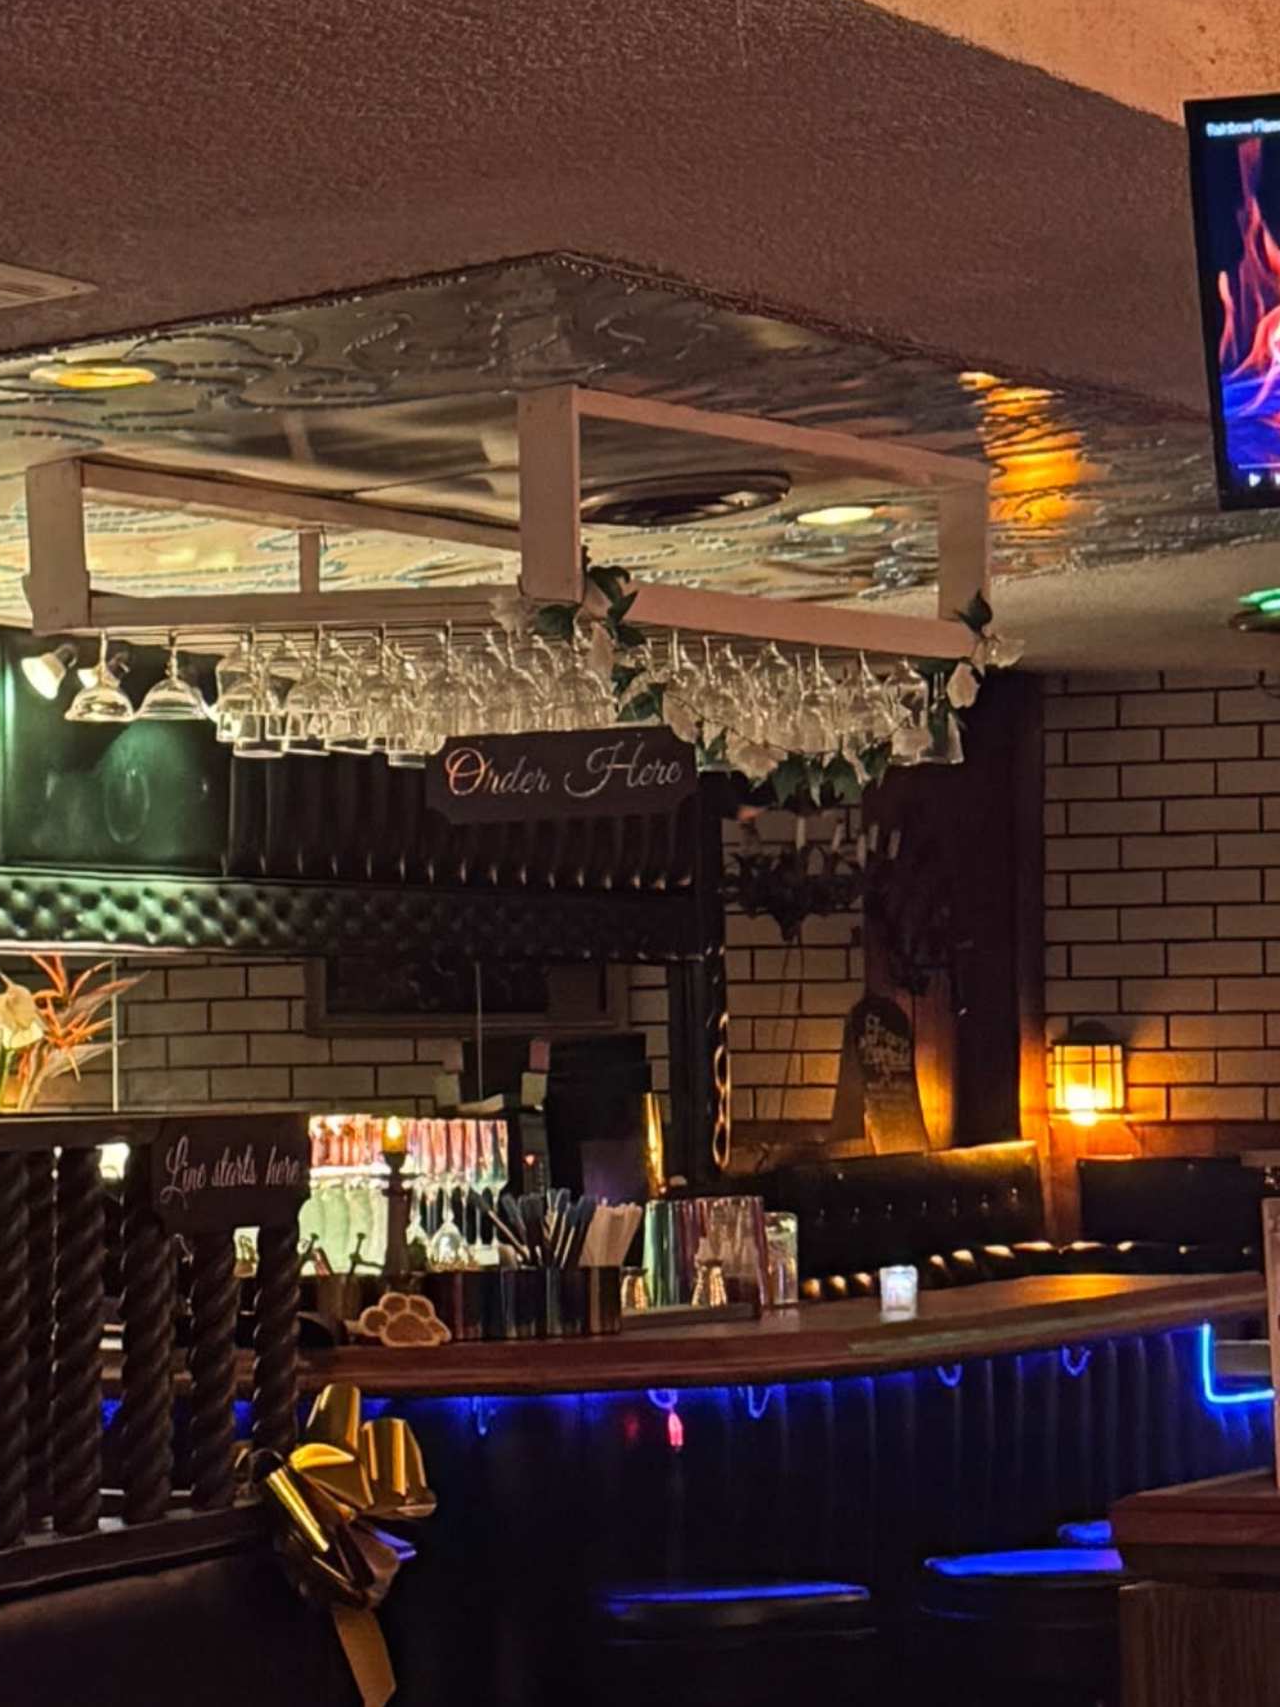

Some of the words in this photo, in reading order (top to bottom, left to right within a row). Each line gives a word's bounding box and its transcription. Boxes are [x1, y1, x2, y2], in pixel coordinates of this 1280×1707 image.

[445, 747, 550, 795] Order
[564, 741, 682, 798] Here
[160, 1135, 207, 1210] Line
[211, 1144, 257, 1187] starts
[265, 1145, 302, 1186] here
